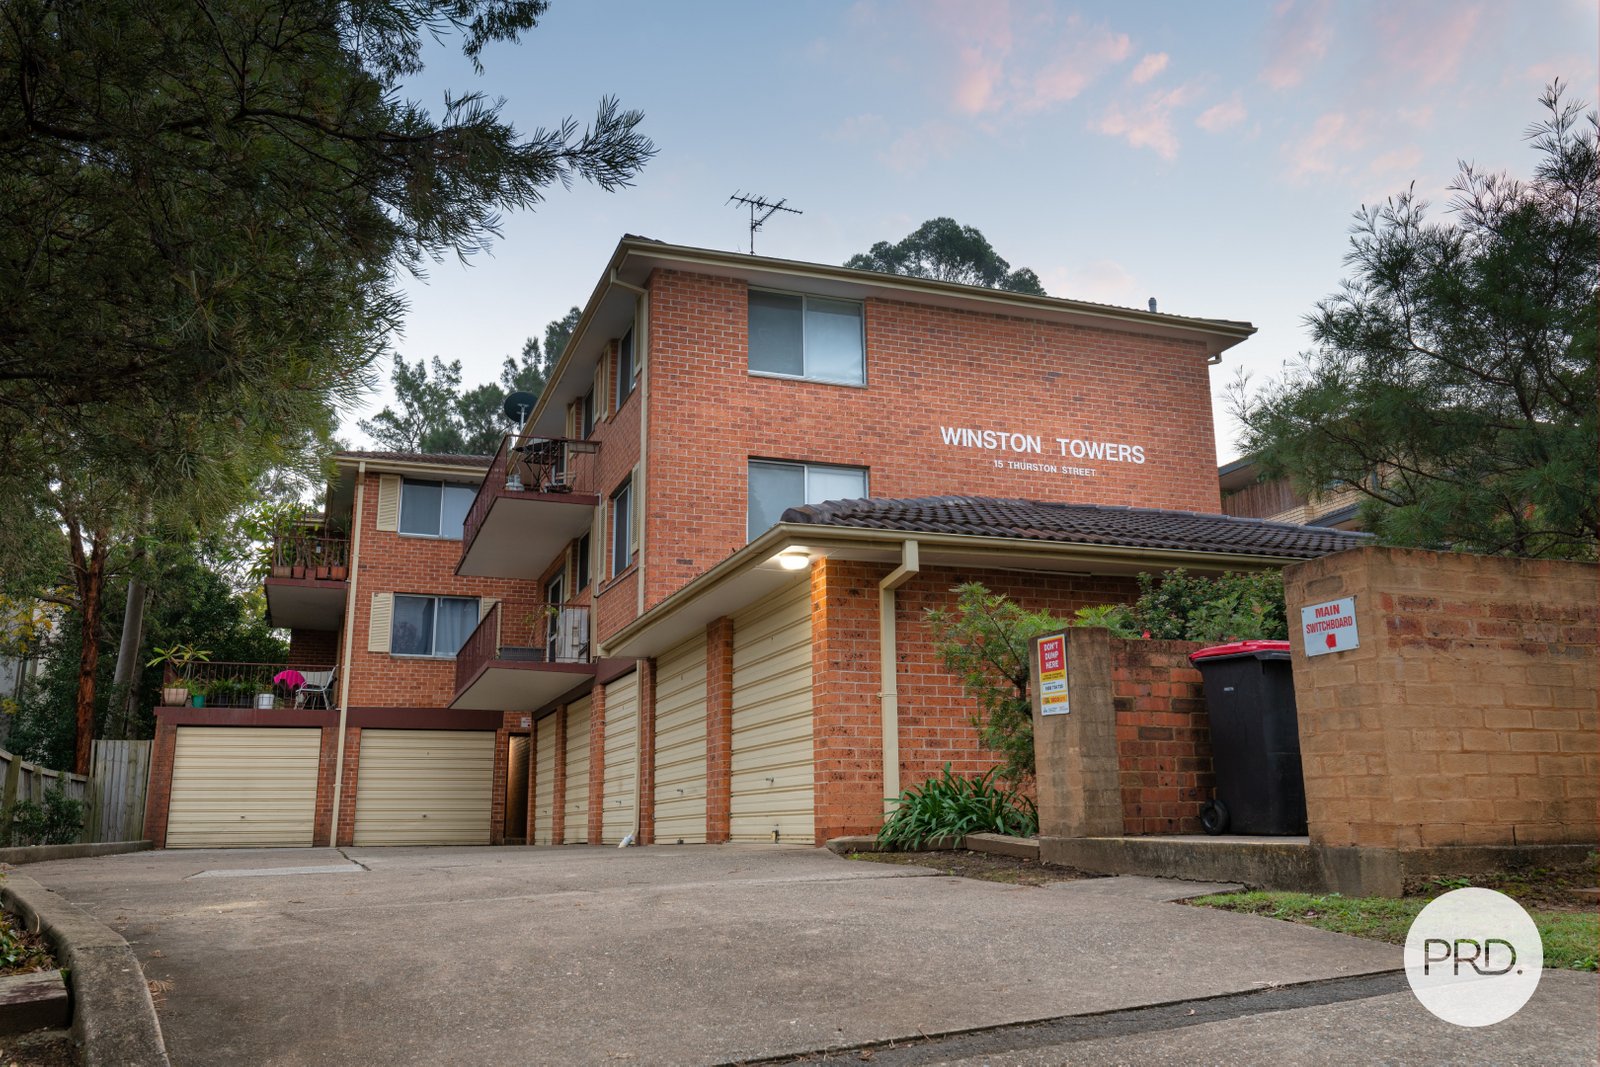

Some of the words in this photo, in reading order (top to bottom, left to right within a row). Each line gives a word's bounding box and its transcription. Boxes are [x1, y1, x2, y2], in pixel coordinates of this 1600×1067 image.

[940, 426, 1041, 454] WINSTON
[1056, 438, 1146, 464] TOWERS
[994, 460, 1004, 469] 15
[1008, 461, 1057, 473] THURSTON
[1062, 466, 1096, 476] STREET
[1315, 604, 1340, 618] MAIN
[1306, 616, 1353, 634] SWITCHBOARD
[1043, 641, 1059, 651] DON'T
[1045, 651, 1059, 660] DUMP
[1045, 660, 1059, 670] HERE
